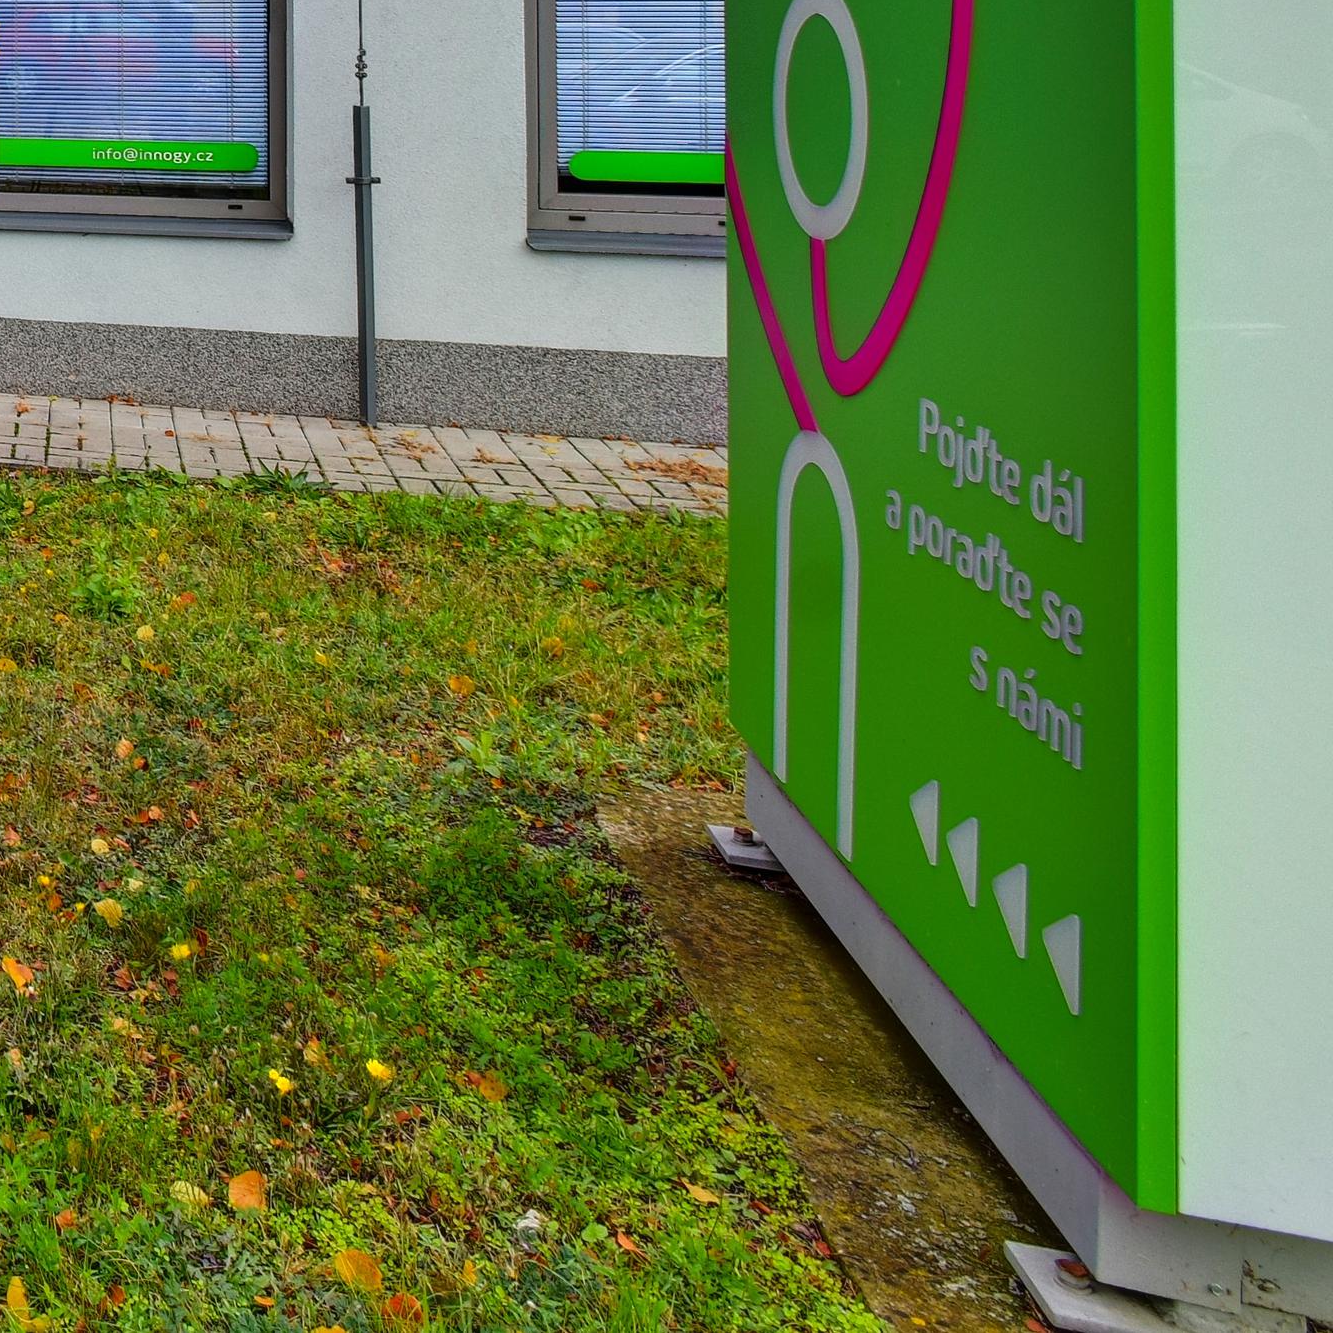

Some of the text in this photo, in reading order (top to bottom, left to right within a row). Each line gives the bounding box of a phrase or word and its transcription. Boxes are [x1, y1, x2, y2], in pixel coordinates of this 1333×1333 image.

[92, 147, 214, 164] info@innogy.cz
[919, 397, 1084, 544] Pojďte dál
[885, 489, 1083, 656] a poraďte se
[969, 646, 1083, 771] s námi
